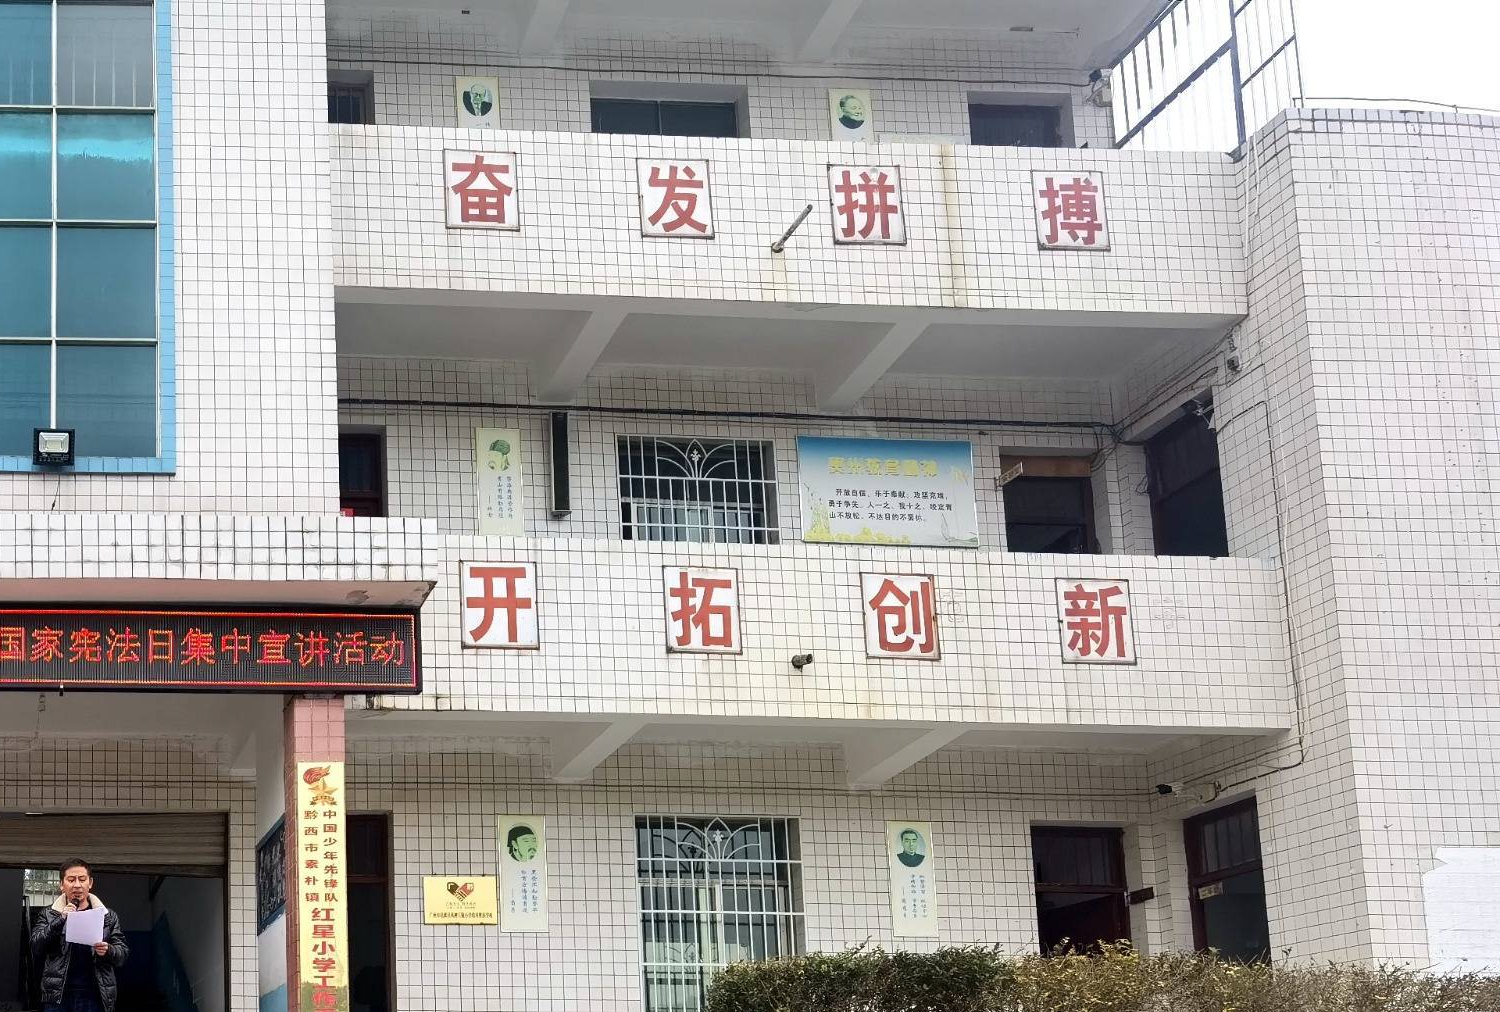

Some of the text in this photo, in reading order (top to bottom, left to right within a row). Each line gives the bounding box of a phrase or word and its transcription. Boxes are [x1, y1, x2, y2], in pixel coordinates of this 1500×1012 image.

[451, 155, 1104, 246] 奋发拼搏
[466, 566, 1129, 659] 开拓创新
[323, 809, 339, 903] 中国少年先锋队
